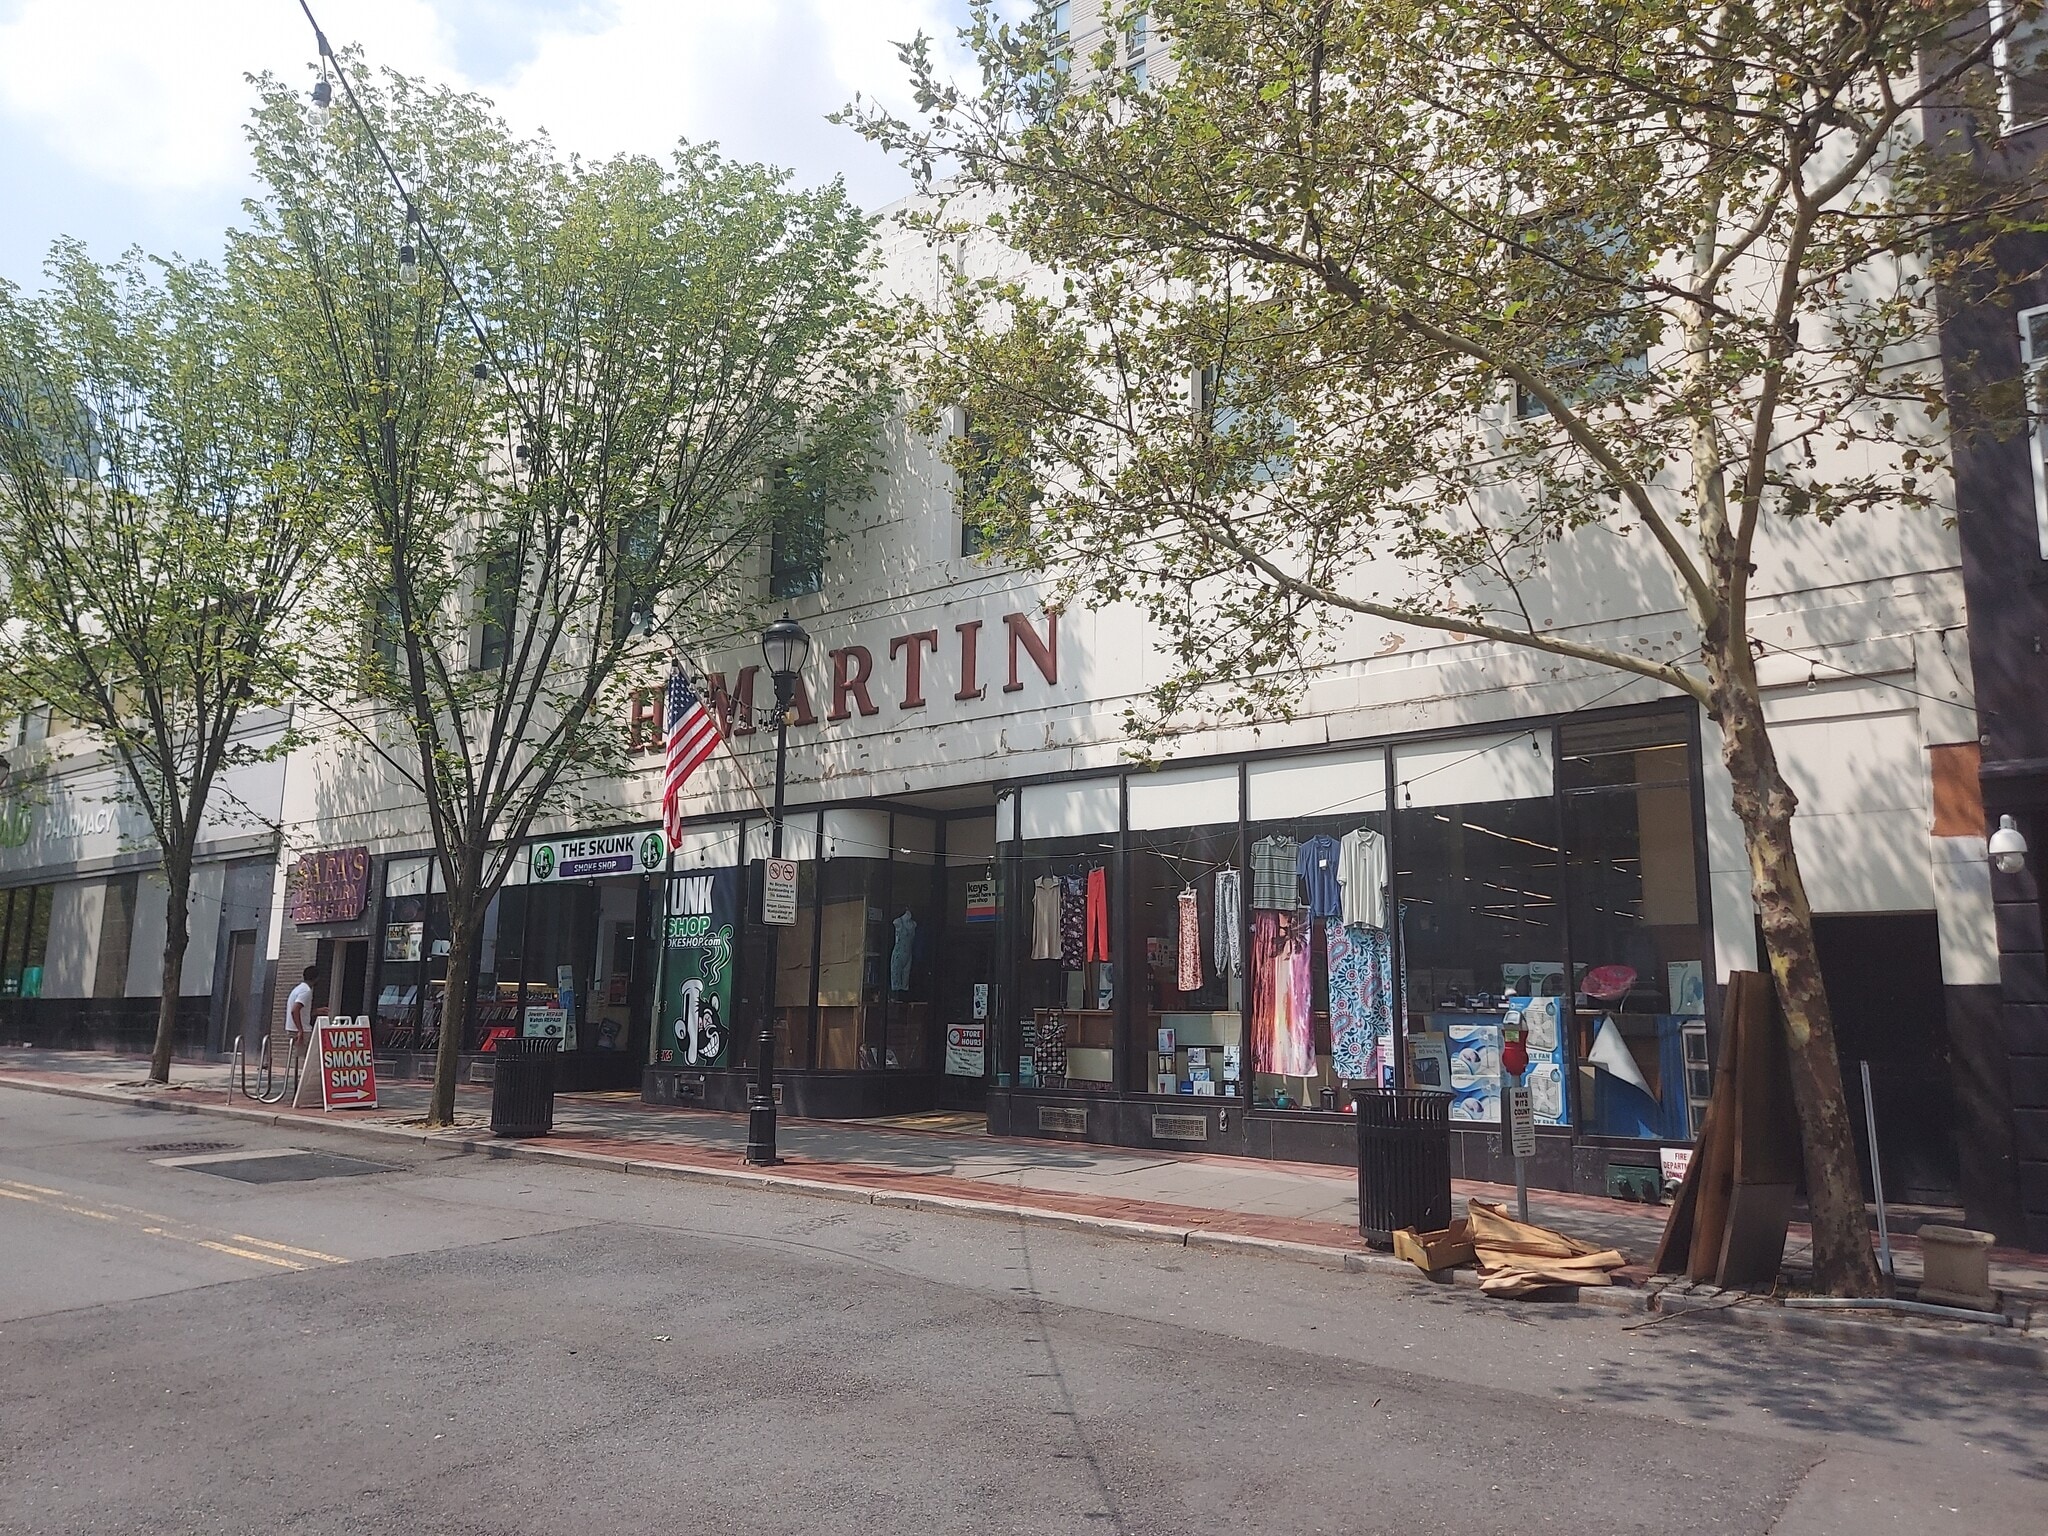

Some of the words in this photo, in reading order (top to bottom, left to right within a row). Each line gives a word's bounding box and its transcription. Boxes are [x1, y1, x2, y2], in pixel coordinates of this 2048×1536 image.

[707, 605, 1060, 739] MARTIN
[45, 808, 116, 840] PHARMACY
[561, 841, 586, 859] THE
[588, 836, 635, 856] SKUNK
[573, 864, 597, 873] SMOKE
[598, 861, 617, 871] SHOP
[968, 883, 989, 894] keys
[328, 1031, 365, 1048] VAPE
[324, 1050, 372, 1068] SMOKE
[1539, 1052, 1551, 1060] FAN
[331, 1069, 368, 1088] SHOP
[1515, 1091, 1528, 1099] MAKE
[1514, 1108, 1530, 1116] COUNT
[1674, 1152, 1688, 1160] FIRE
